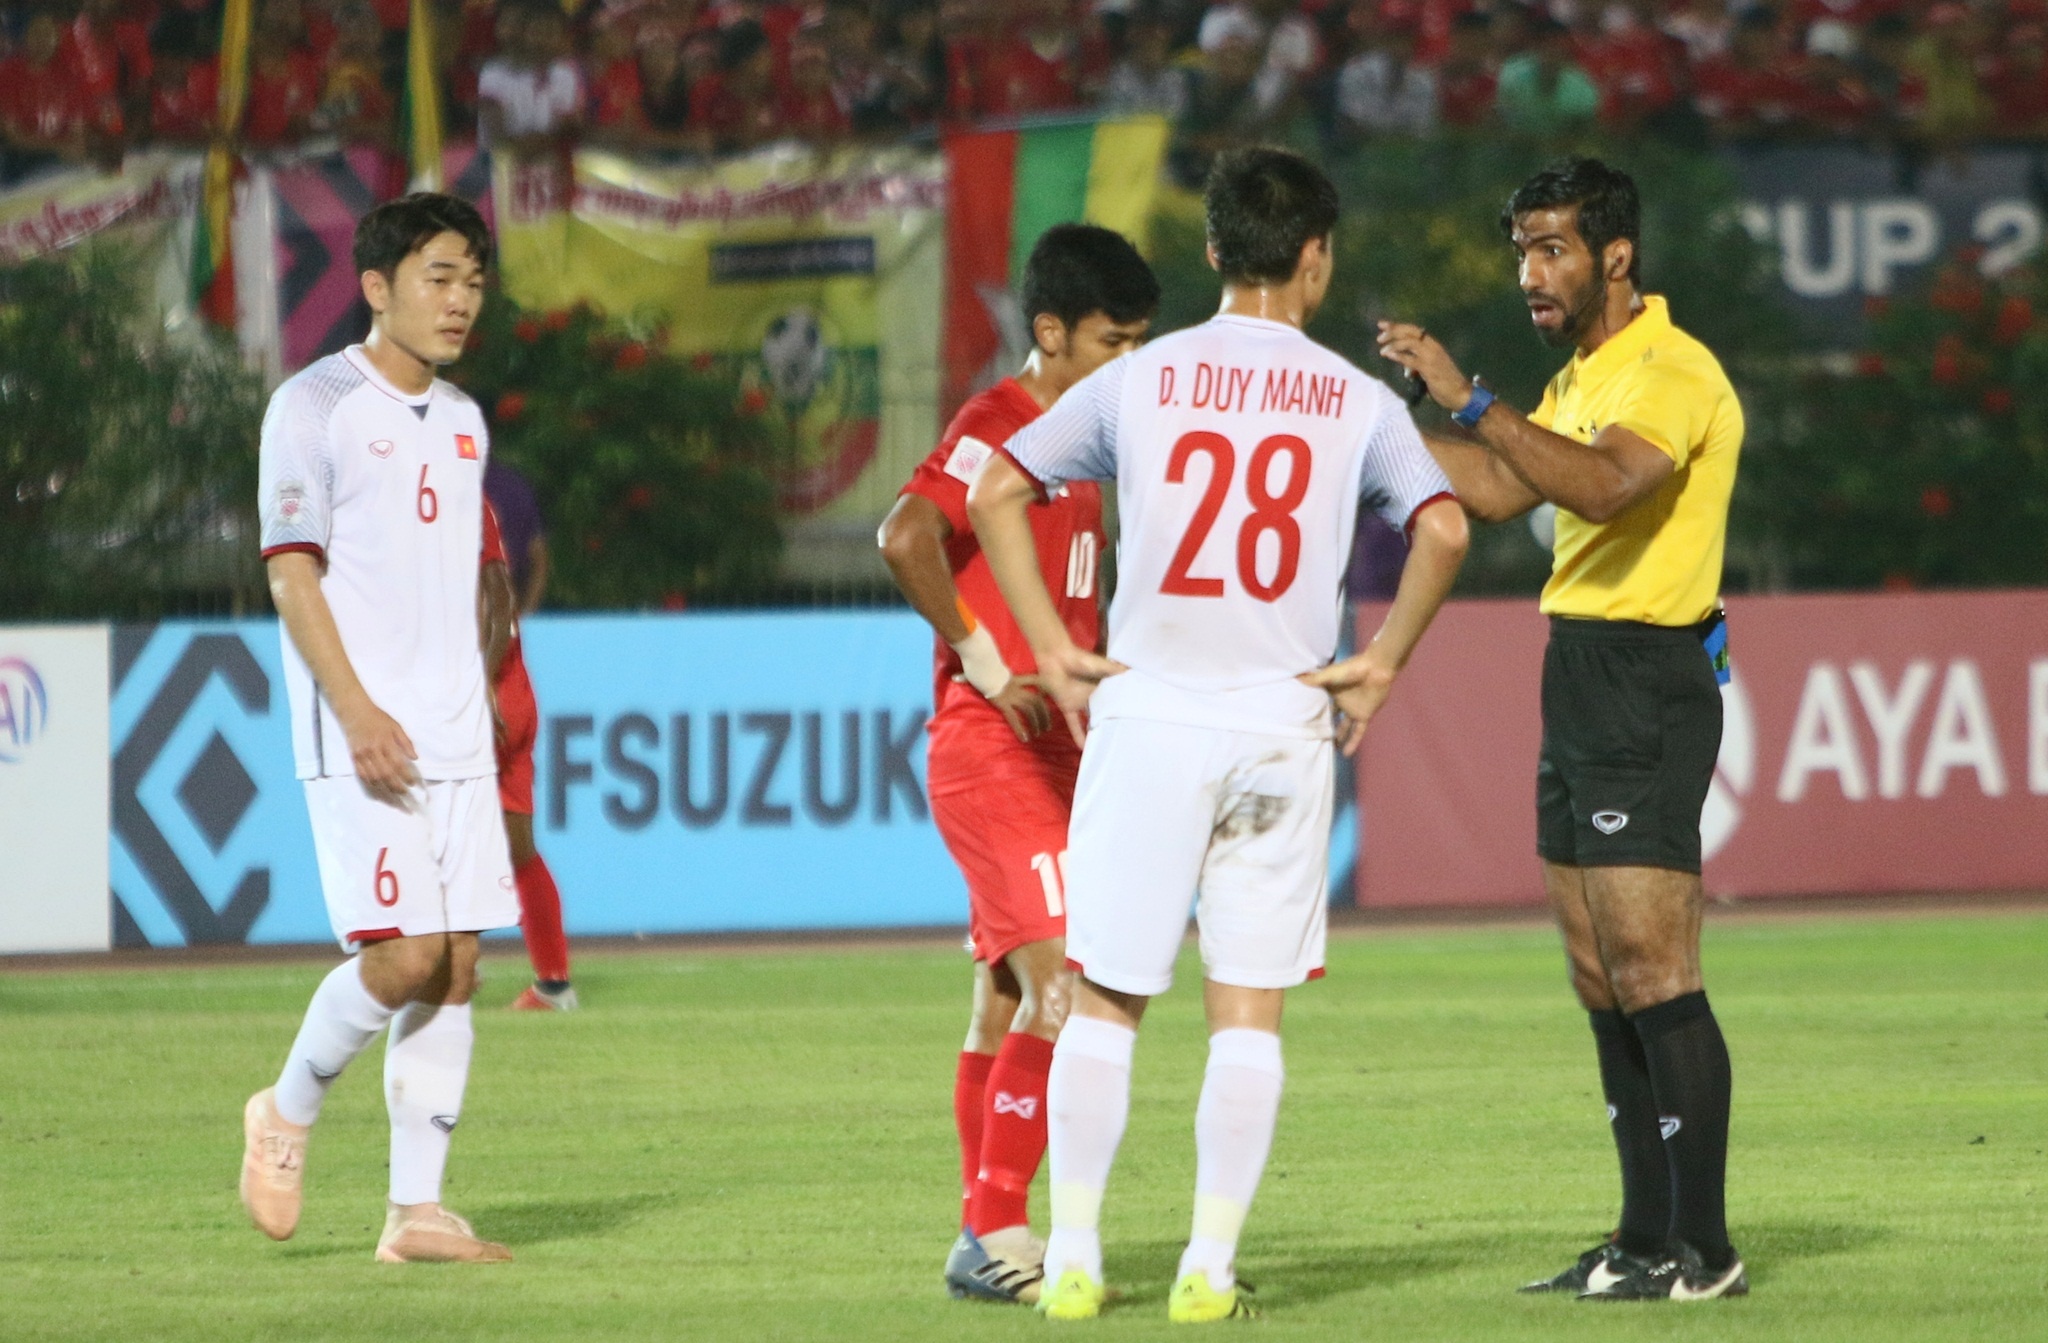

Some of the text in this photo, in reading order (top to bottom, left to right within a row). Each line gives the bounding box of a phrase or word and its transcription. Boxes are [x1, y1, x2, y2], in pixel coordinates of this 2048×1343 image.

[1741, 197, 1938, 298] UP
[1159, 361, 1347, 420] D. DUY MANH
[416, 462, 438, 524] 6
[1158, 430, 1312, 604] 28
[1065, 530, 1096, 599] 10
[1776, 658, 2007, 802] AYA
[373, 846, 400, 909] 6
